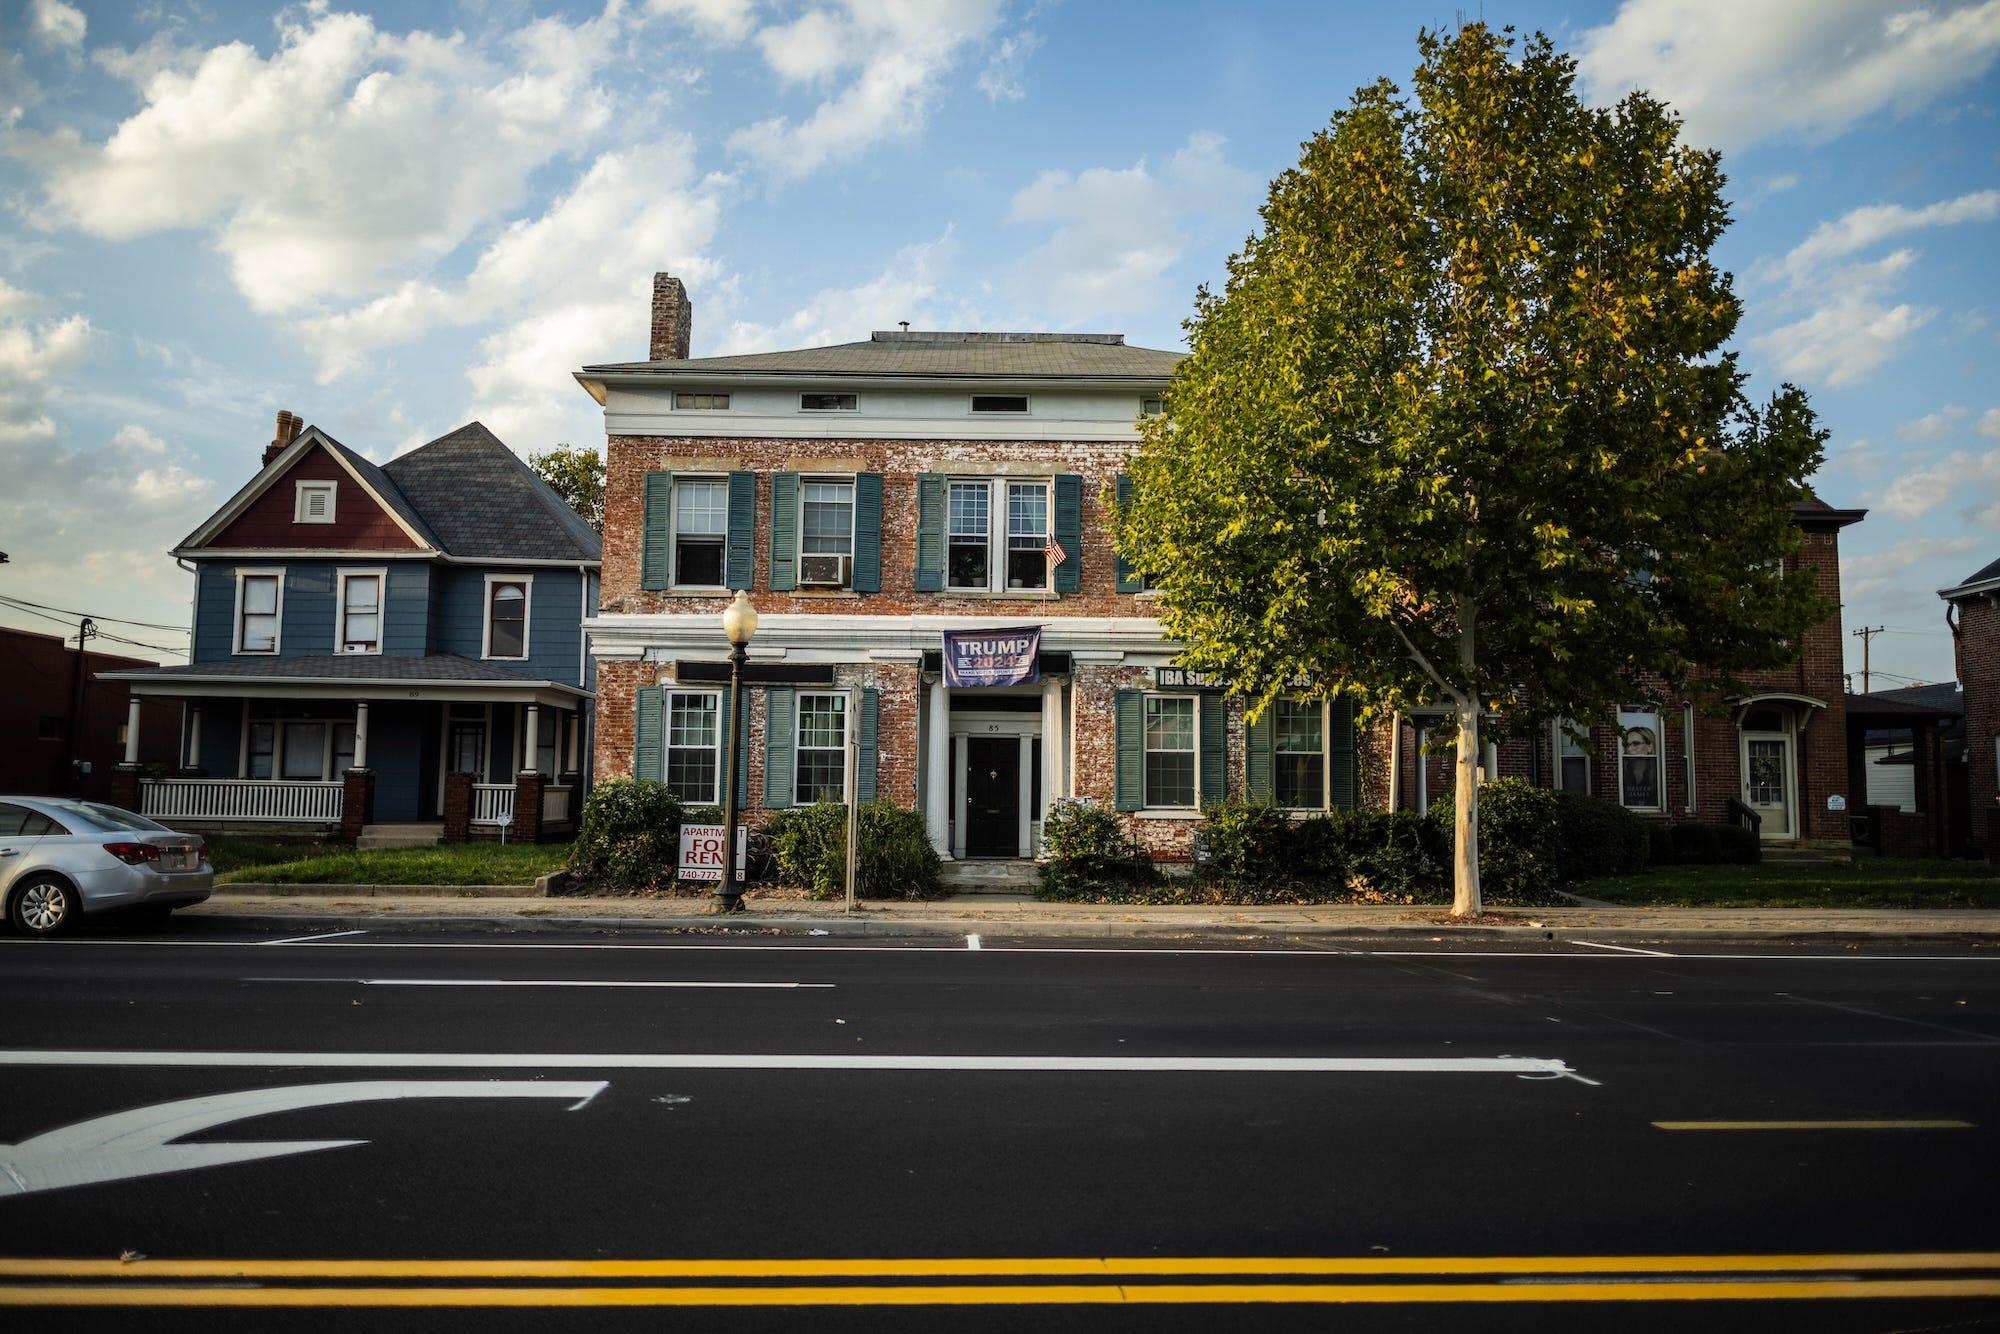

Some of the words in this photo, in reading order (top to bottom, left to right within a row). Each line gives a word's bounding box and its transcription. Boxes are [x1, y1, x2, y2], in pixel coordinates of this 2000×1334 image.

[958, 639, 1030, 655] TRUMP
[972, 656, 1017, 668] 2024
[1159, 670, 1185, 686] IBA
[683, 828, 745, 838] APARTMT
[692, 839, 724, 852] FO
[685, 851, 740, 864] REN
[680, 871, 743, 880] 740-772-8
